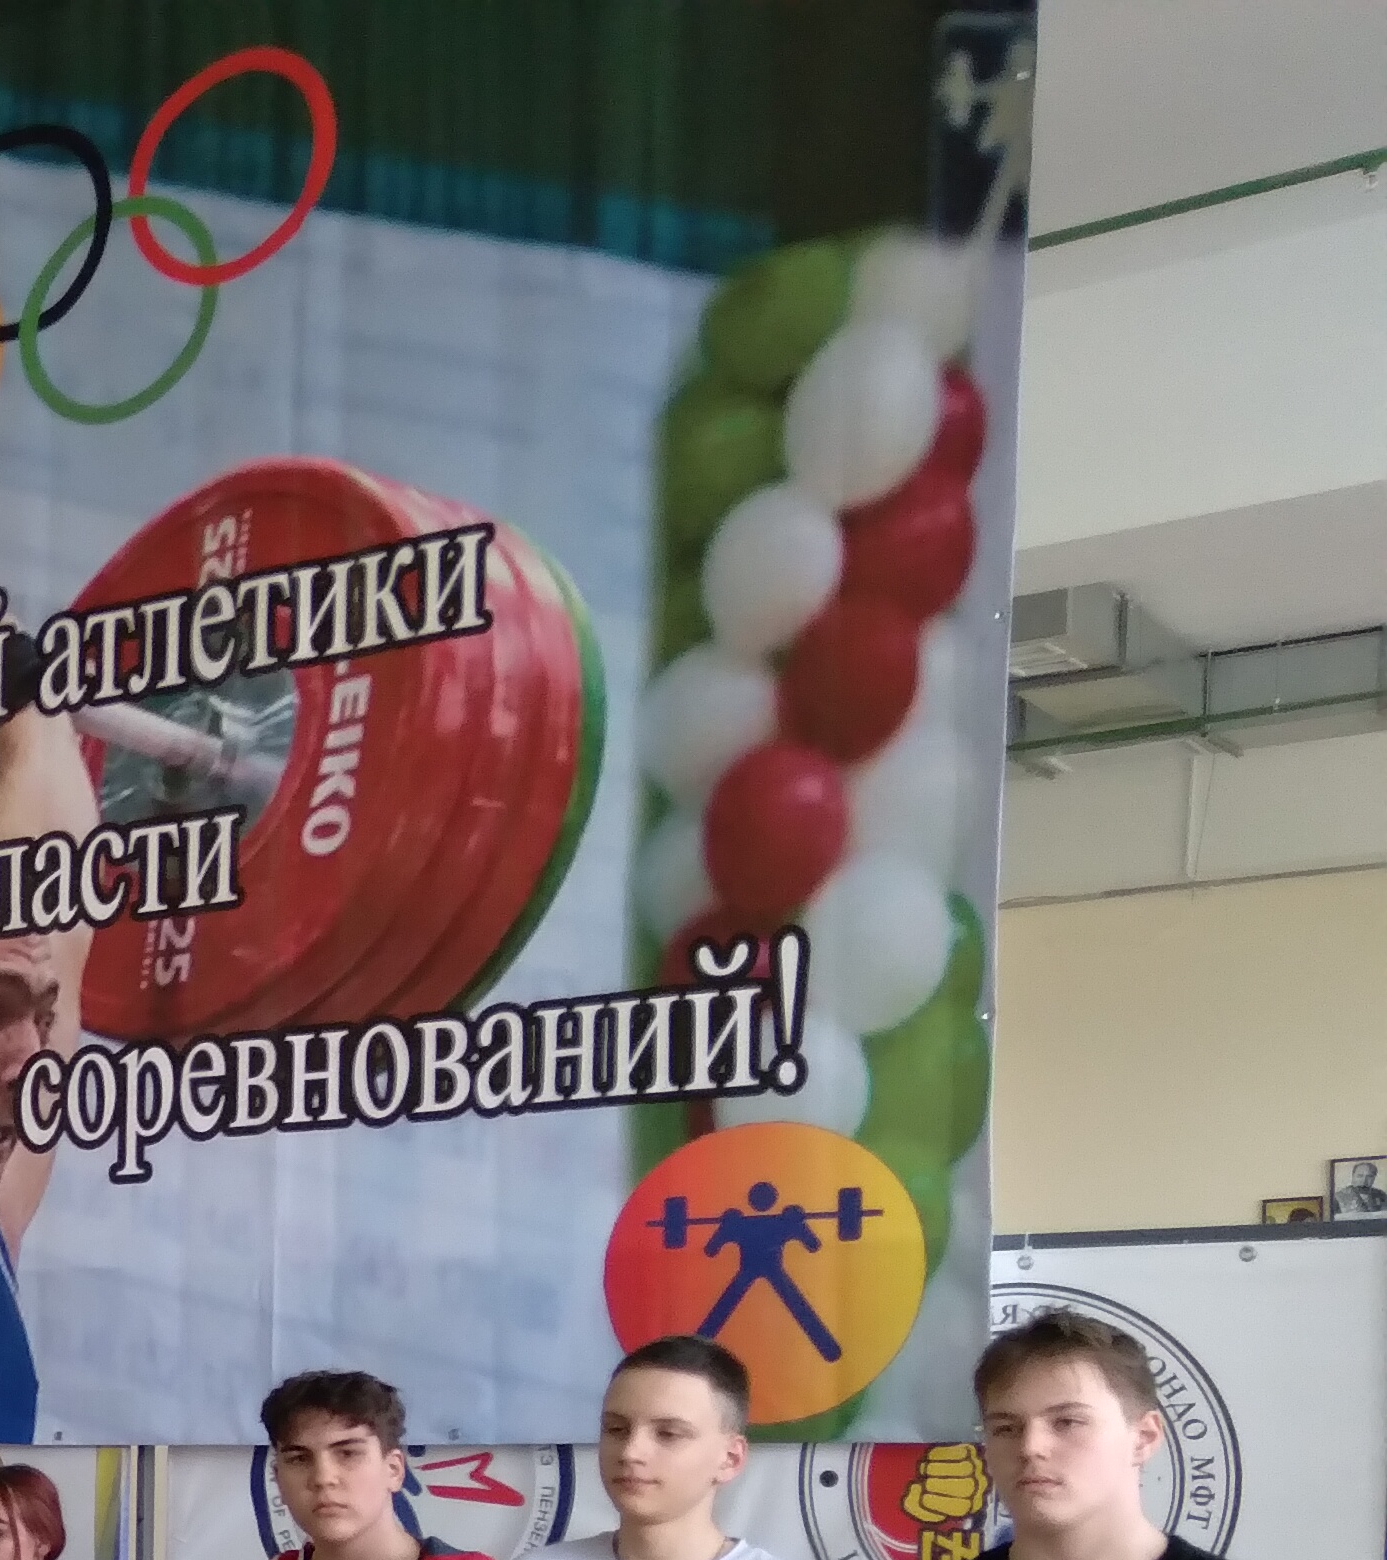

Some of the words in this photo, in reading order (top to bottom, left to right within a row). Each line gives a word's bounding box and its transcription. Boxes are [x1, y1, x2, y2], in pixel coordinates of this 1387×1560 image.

[38, 524, 495, 715] атлетики
[300, 658, 372, 858] EIKO
[20, 932, 810, 1184] соревнований!
